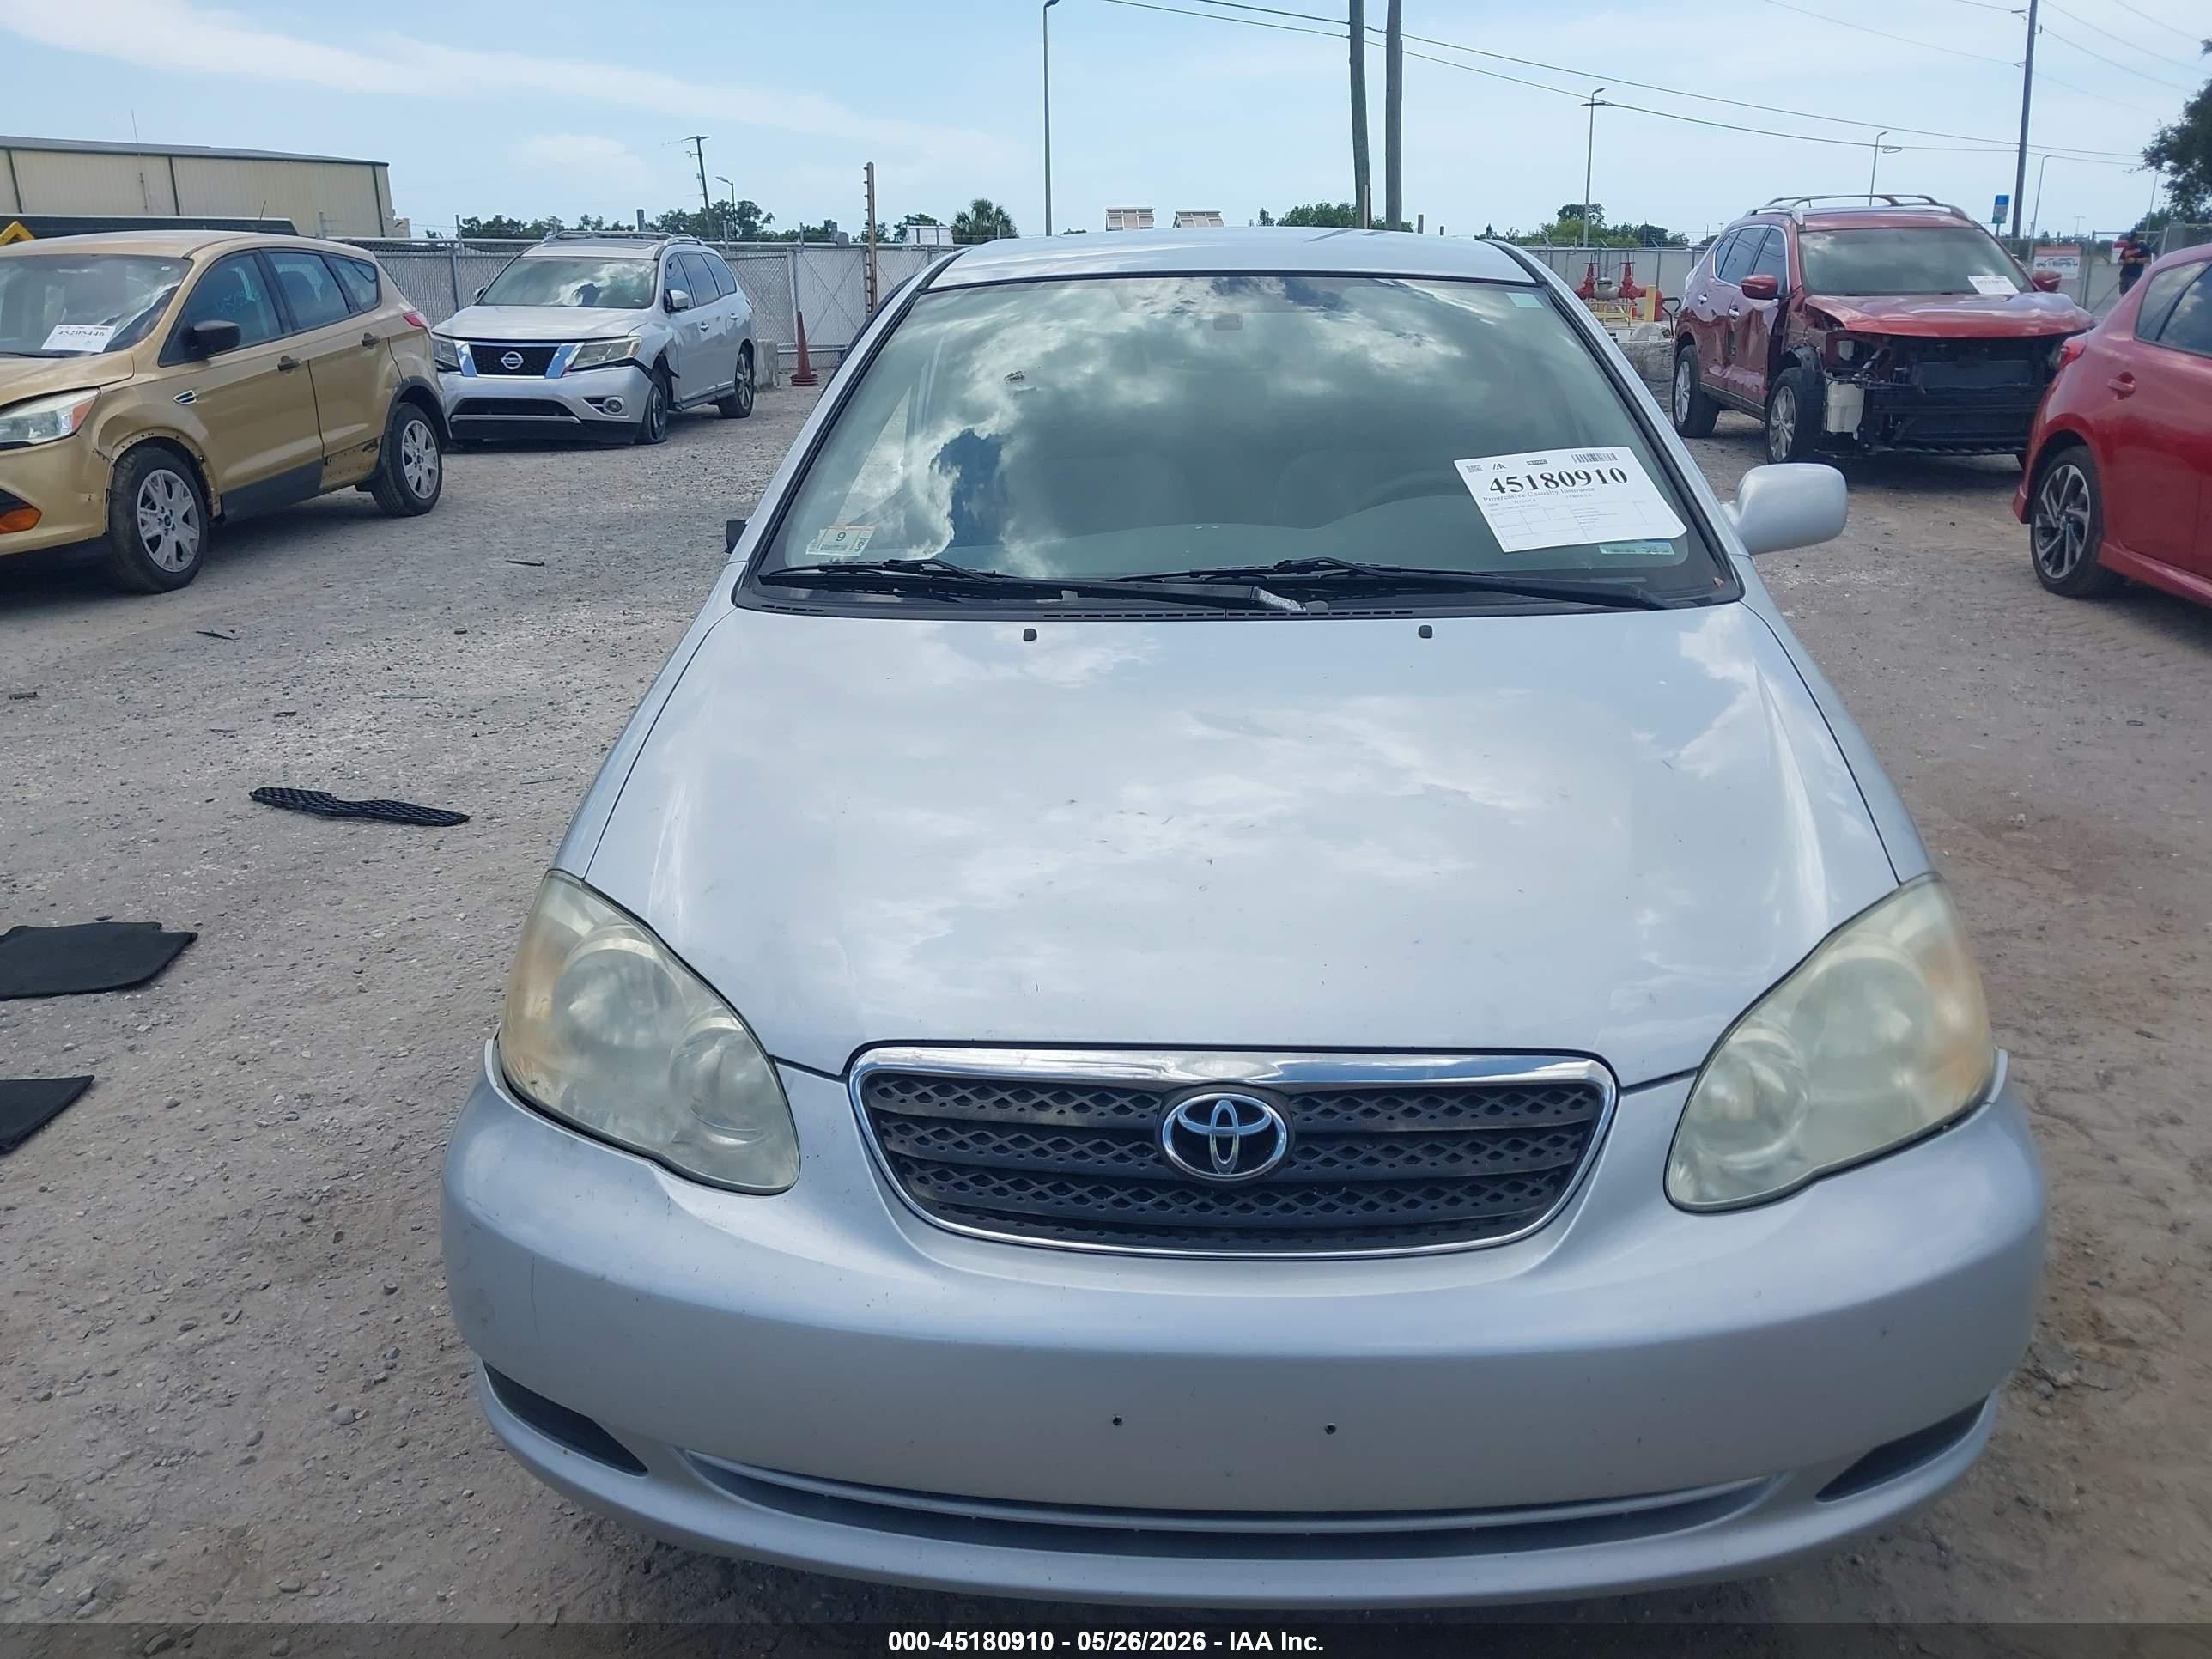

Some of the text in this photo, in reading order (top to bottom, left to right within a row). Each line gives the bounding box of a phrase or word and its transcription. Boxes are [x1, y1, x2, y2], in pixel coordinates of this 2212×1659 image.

[1490, 467, 1628, 494] 45180910
[1483, 494, 1526, 502] Progressive
[836, 532, 846, 542] 9
